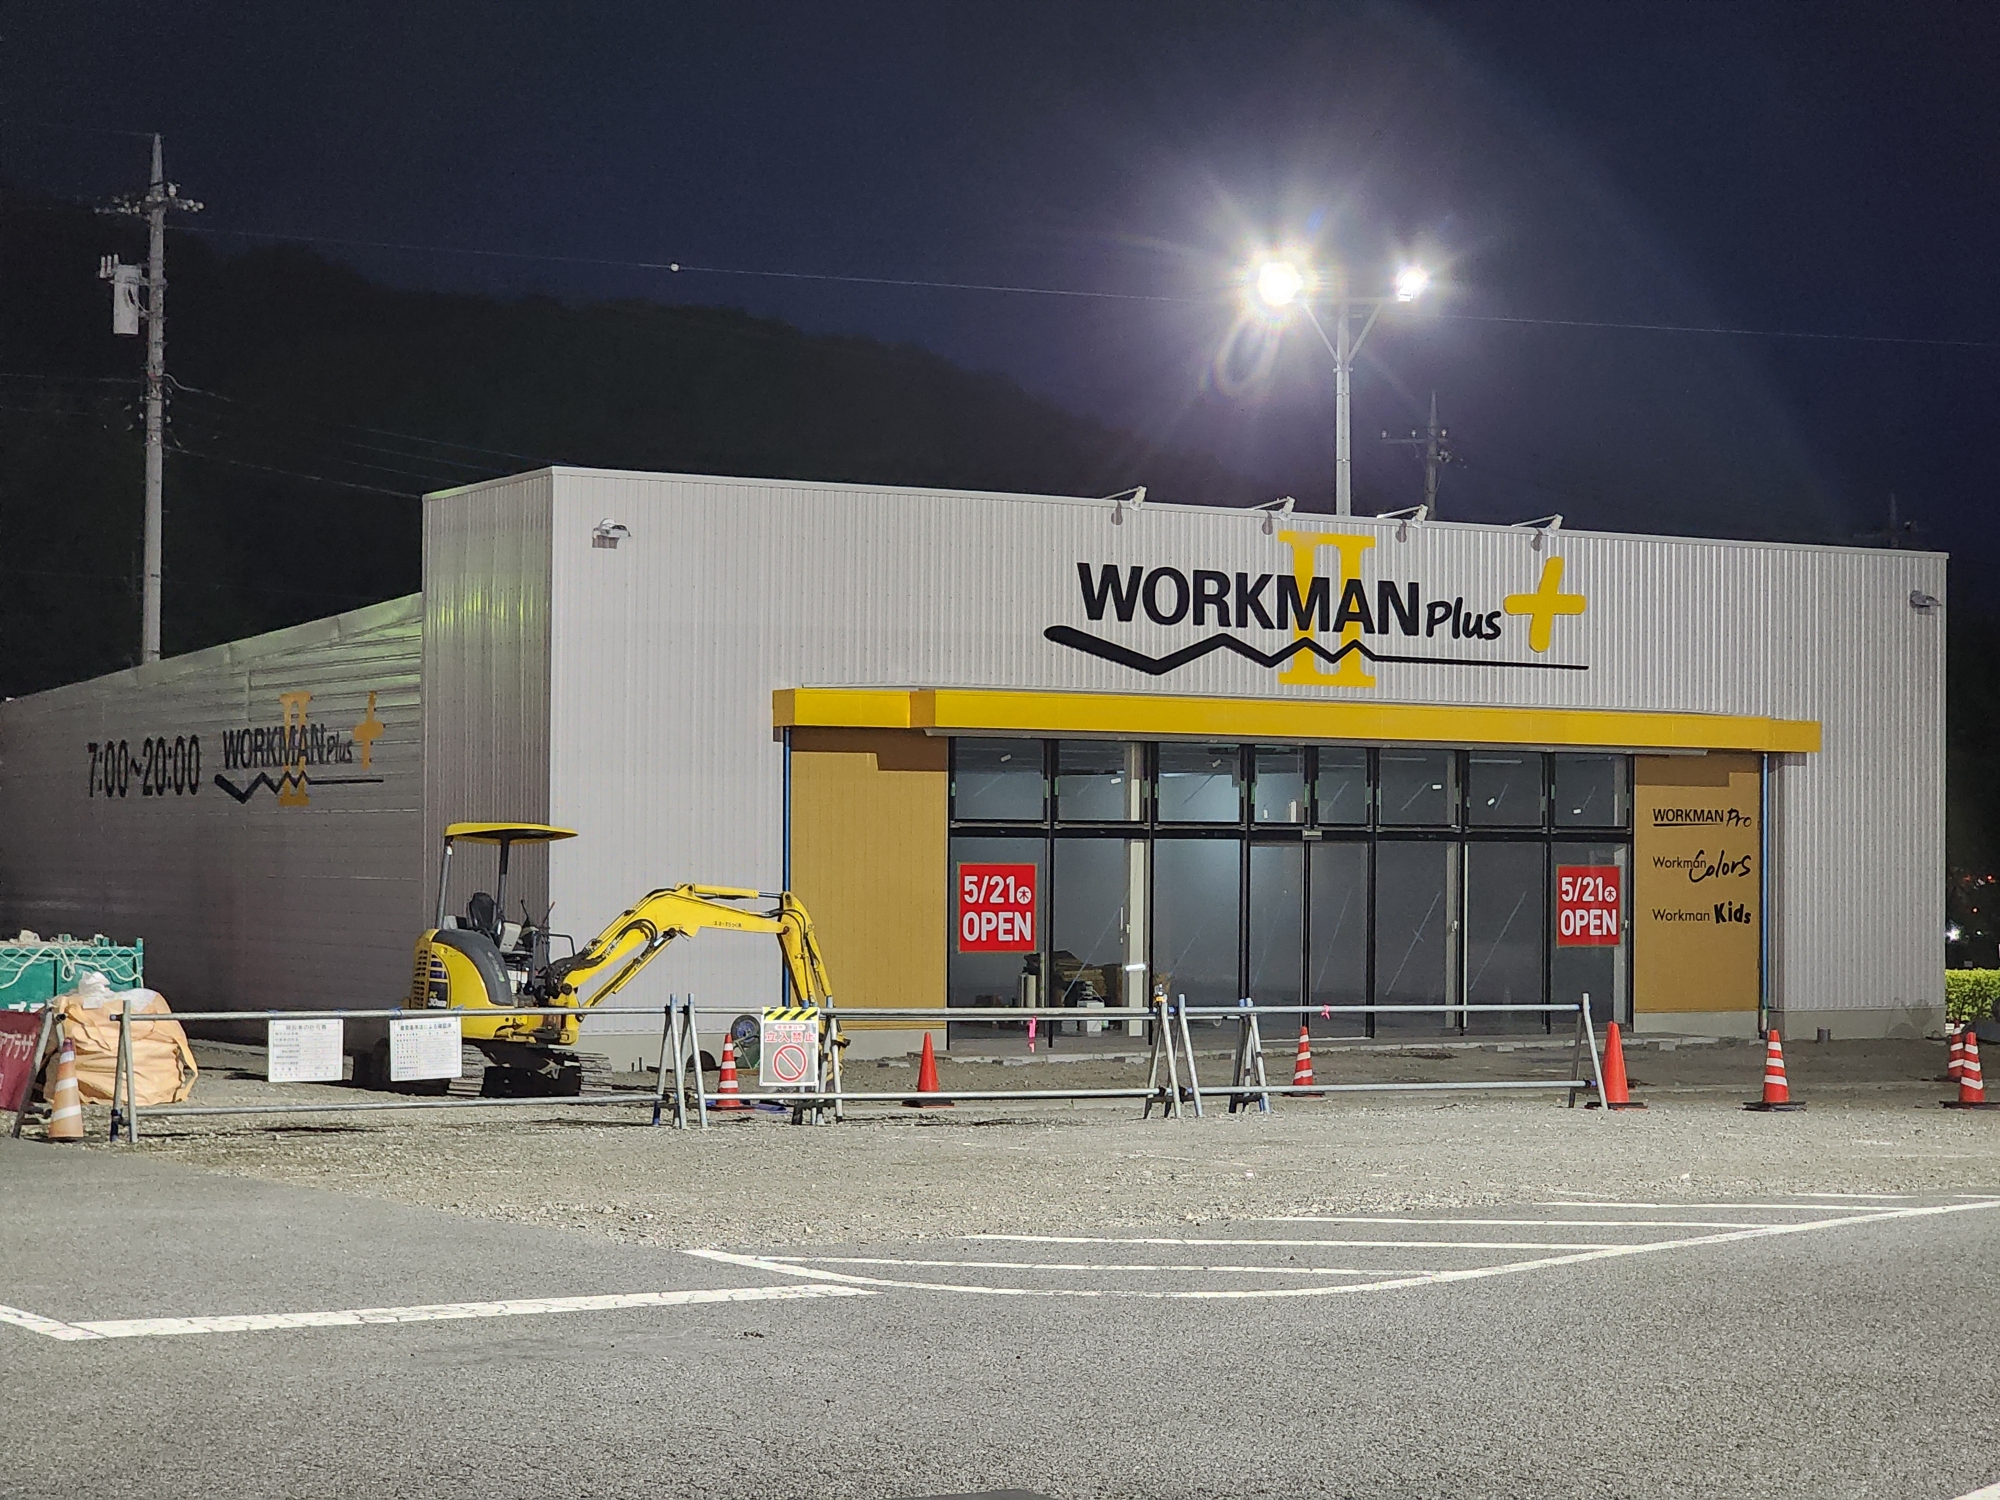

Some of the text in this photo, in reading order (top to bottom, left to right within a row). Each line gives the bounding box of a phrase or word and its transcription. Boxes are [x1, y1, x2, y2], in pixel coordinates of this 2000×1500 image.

[1076, 562, 1502, 641] WORKMAN Plus
[222, 723, 354, 770] WORKMAN Plus
[1653, 808, 1752, 828] WORKMAN Pro
[1652, 849, 1752, 883] Workman Colors
[962, 911, 1032, 942] OPEN
[1560, 908, 1617, 936] OPEN
[1651, 900, 1752, 925] Workman Kids
[765, 1031, 815, 1043] 立入禁止
